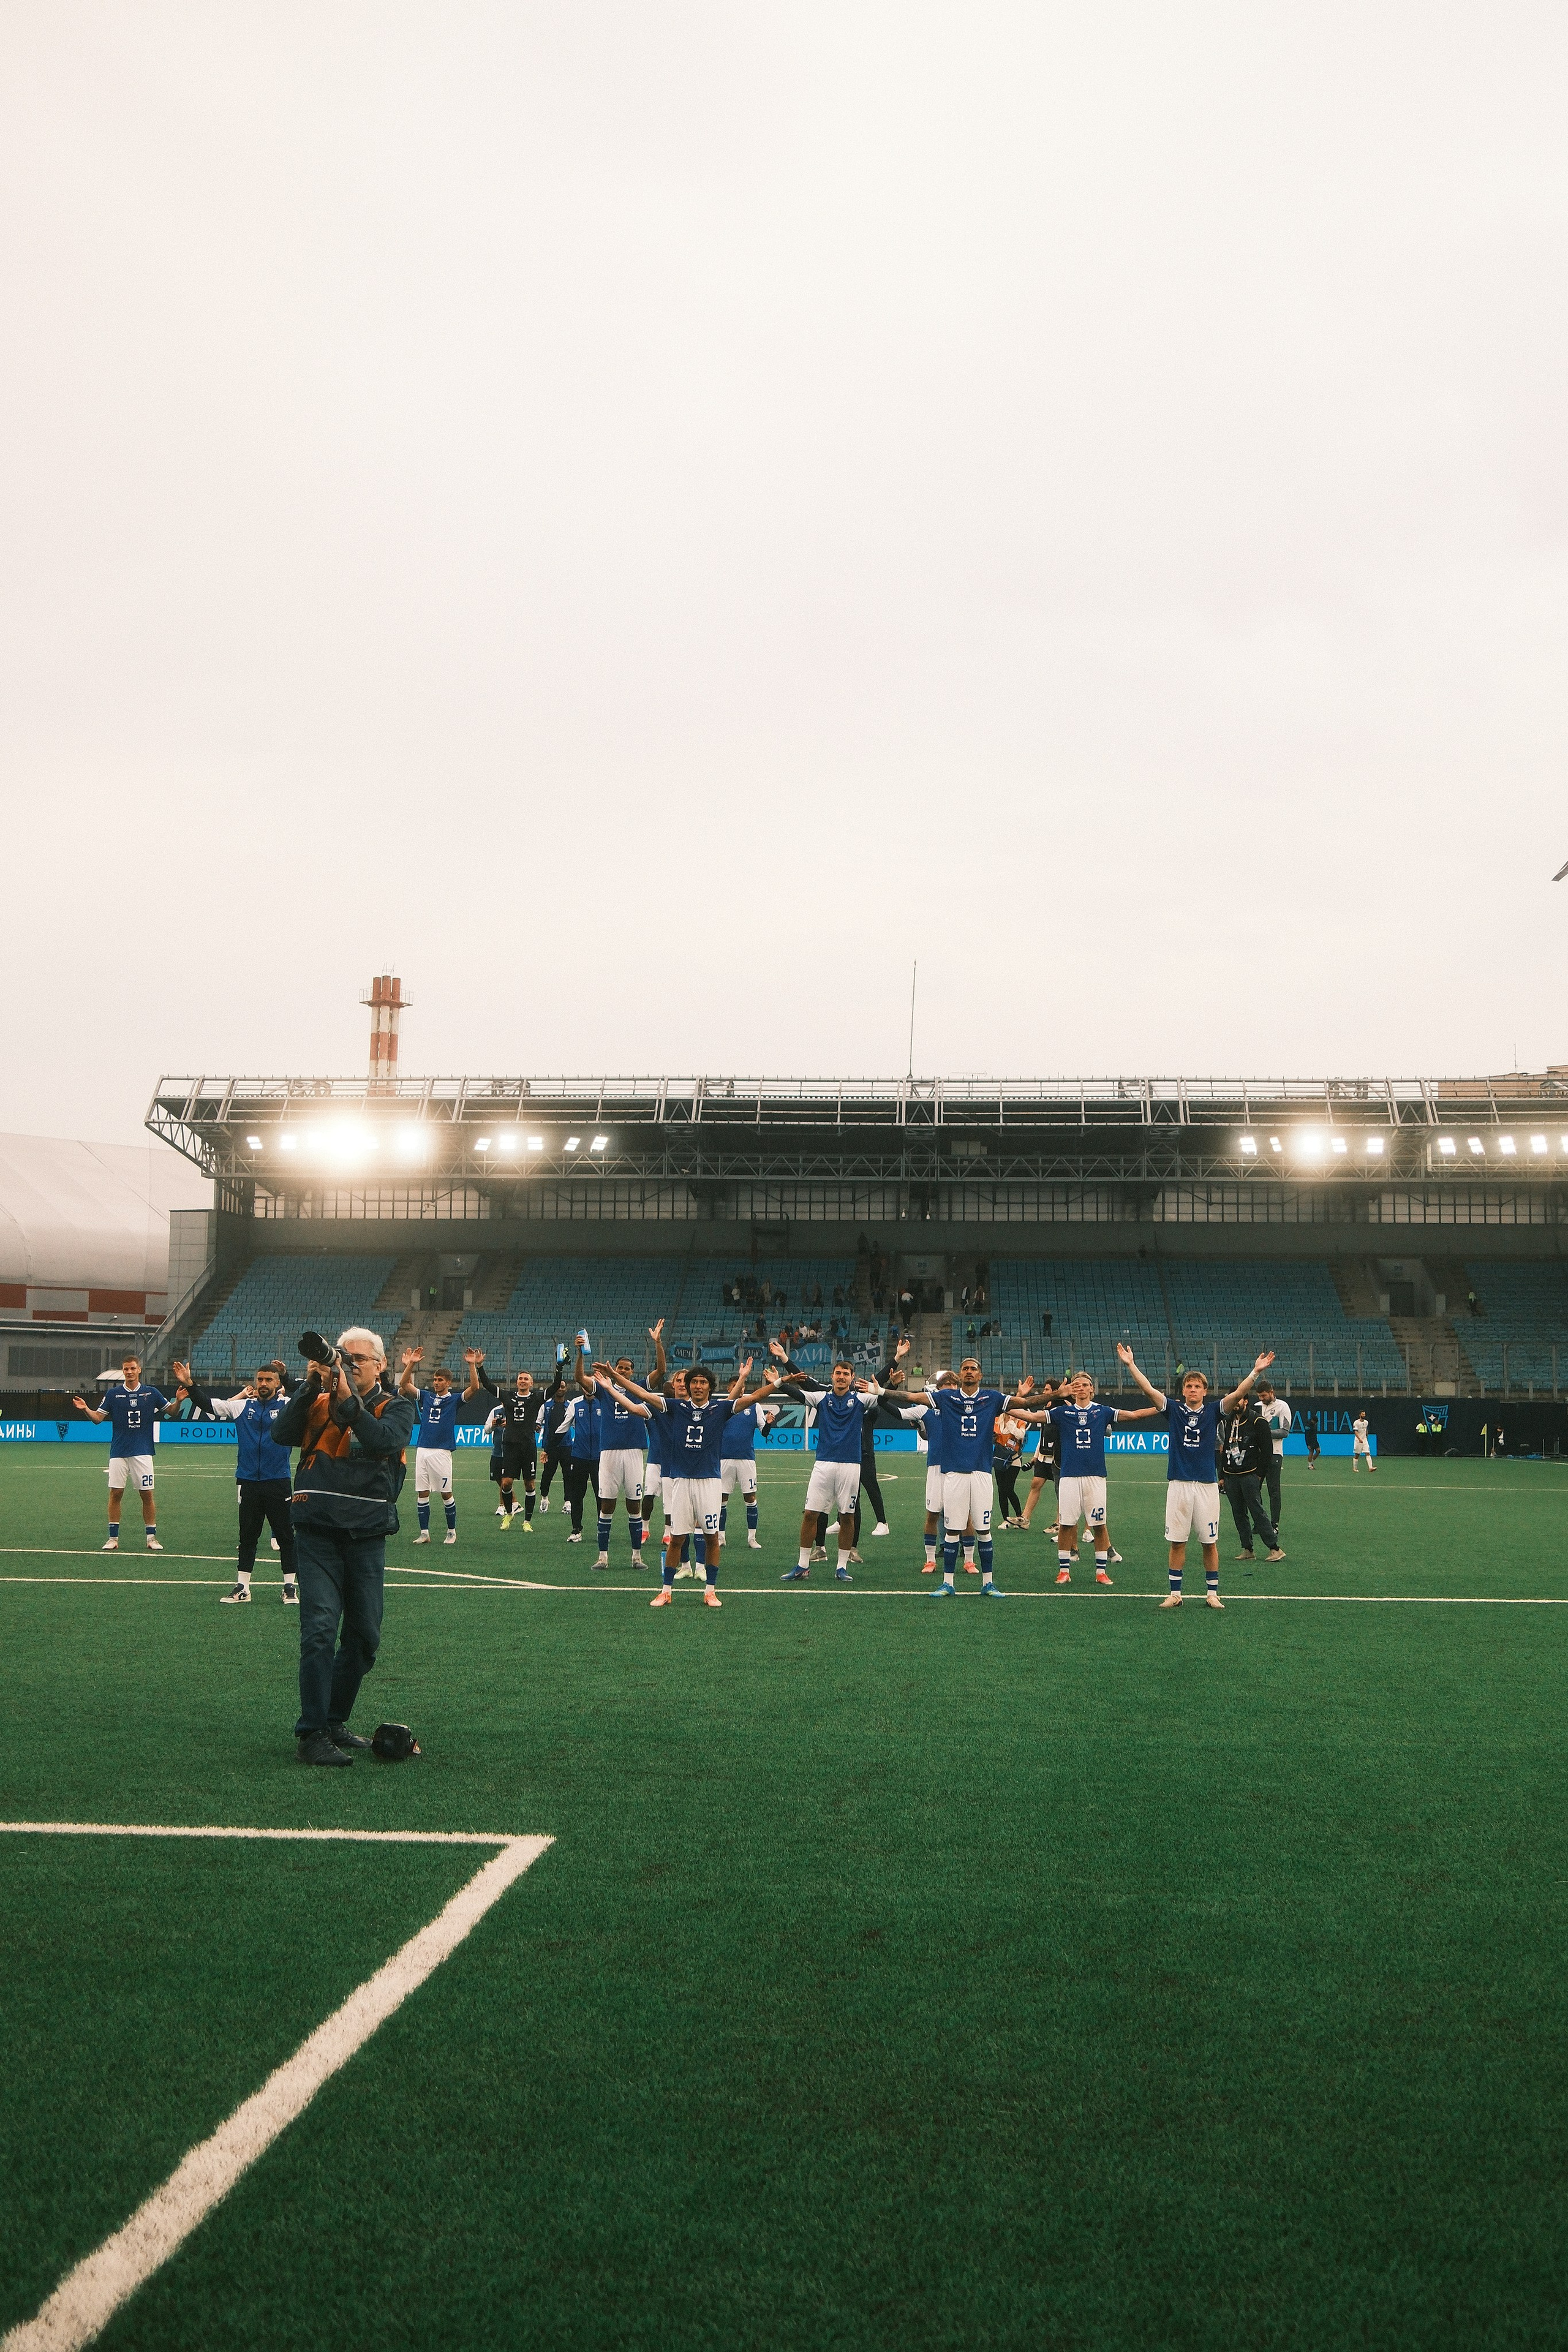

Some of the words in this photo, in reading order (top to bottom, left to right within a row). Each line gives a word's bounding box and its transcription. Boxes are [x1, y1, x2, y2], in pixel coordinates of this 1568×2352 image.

[180, 1428, 236, 1438] RODIN
[456, 1427, 494, 1444] АТРИ
[766, 1434, 820, 1444] RODN
[530, 1461, 535, 1472] 1
[142, 1475, 153, 1487] 26
[442, 1477, 448, 1488] 7
[636, 1483, 643, 1496] 2
[849, 1496, 856, 1509] 3
[1091, 1507, 1104, 1521] 42
[705, 1513, 717, 1529] 22
